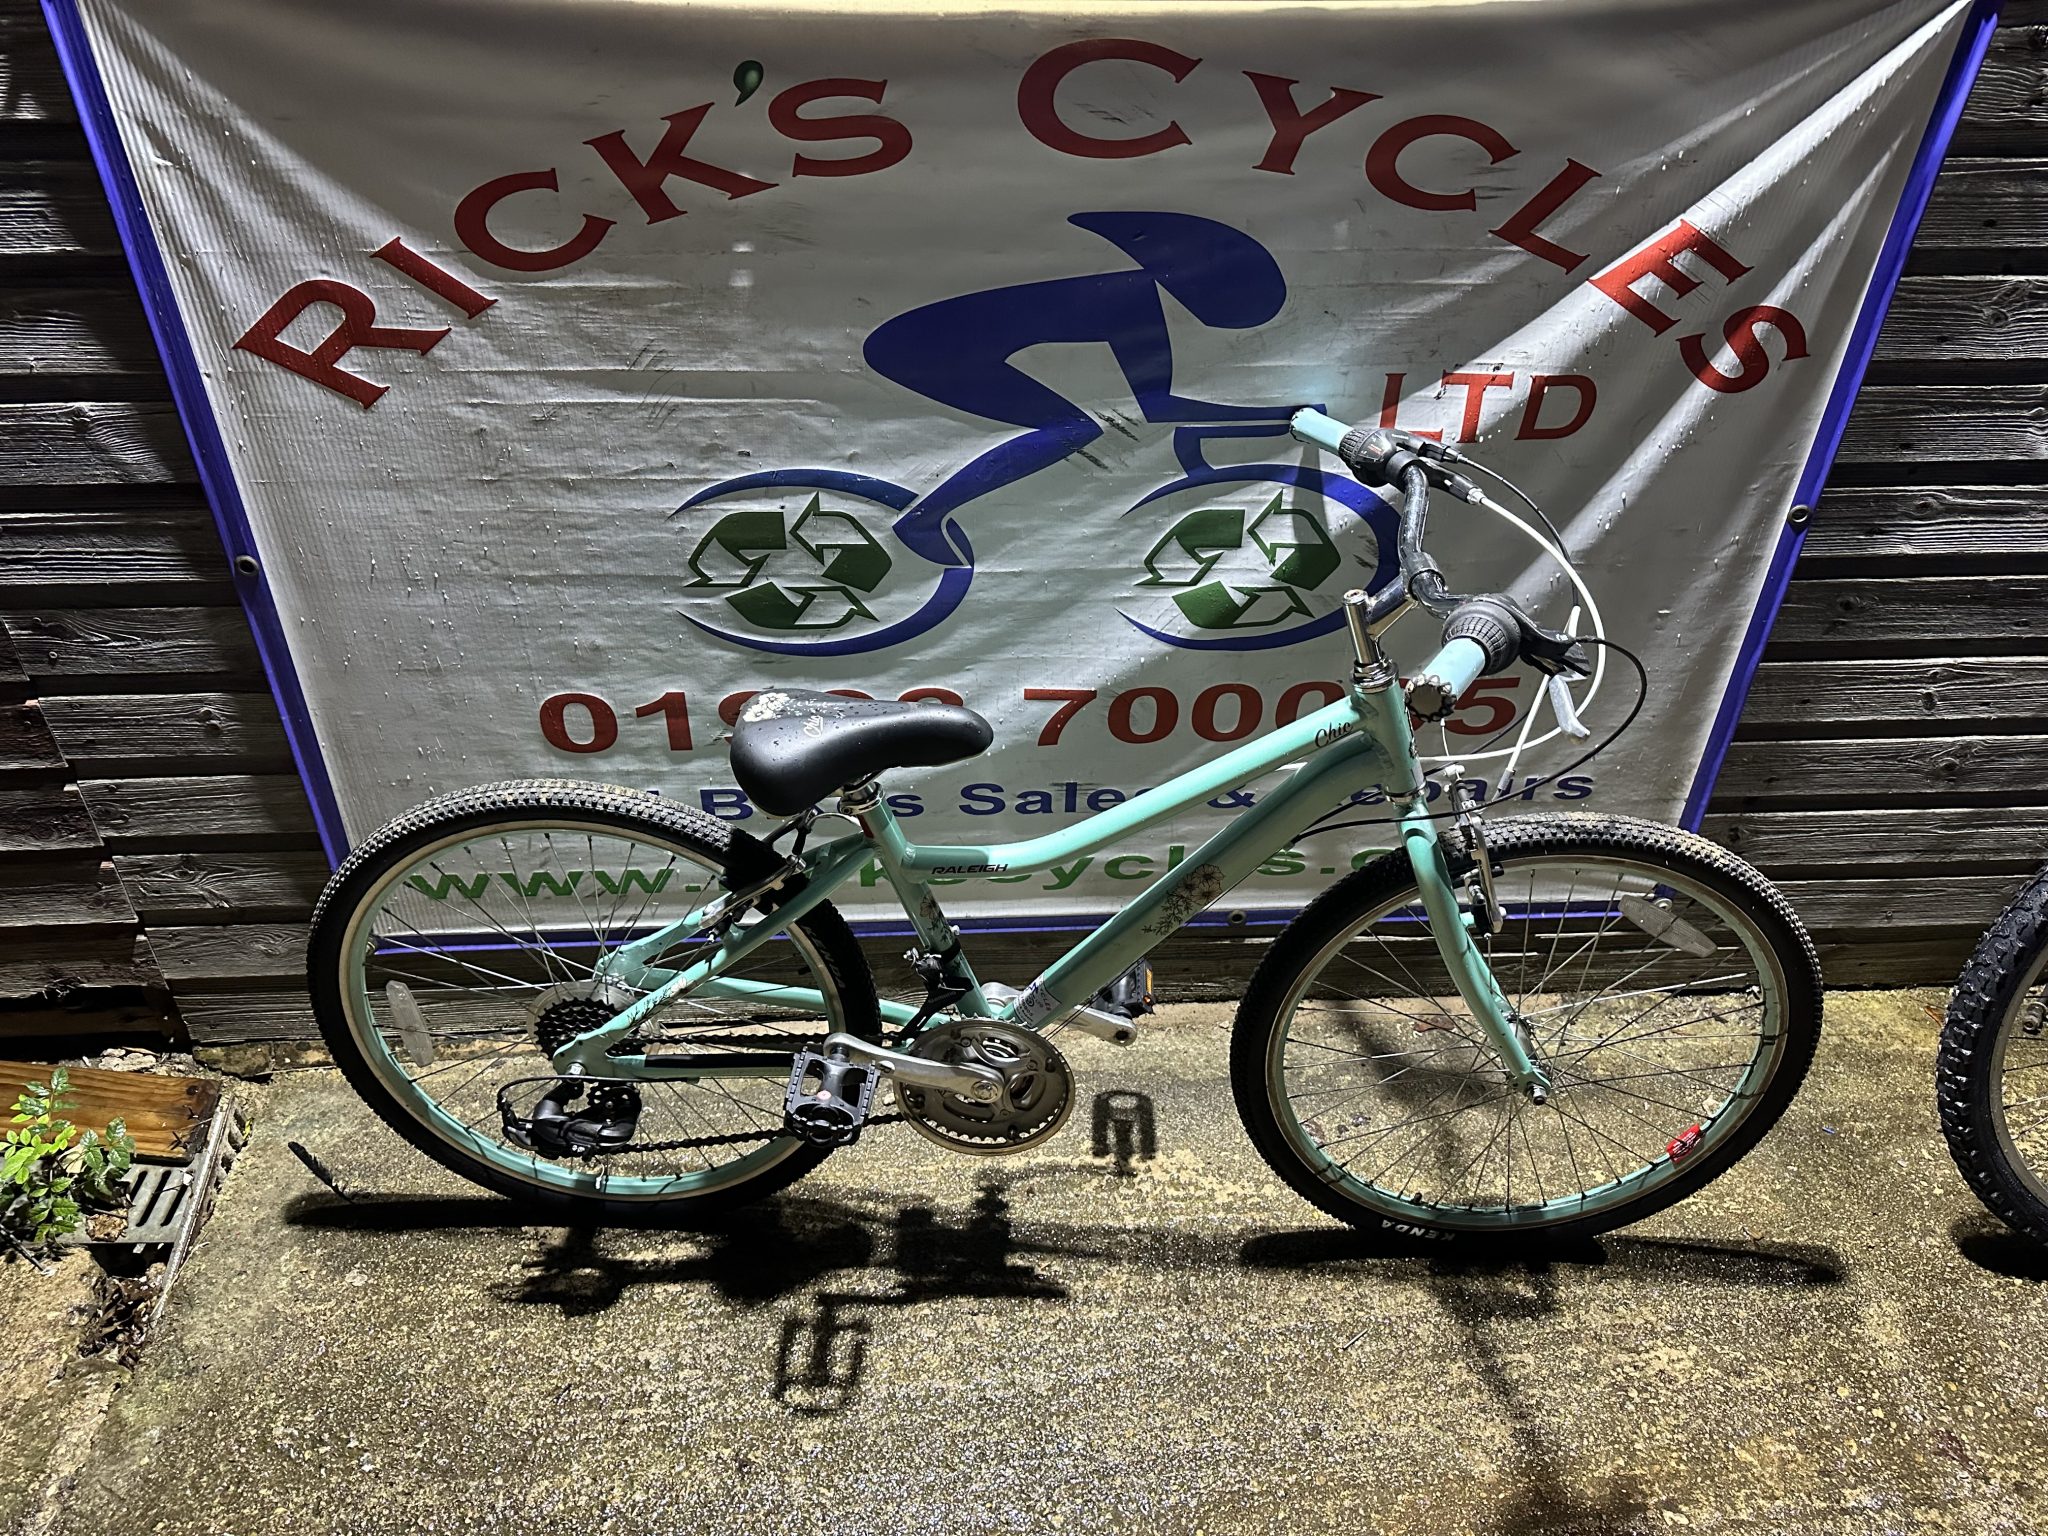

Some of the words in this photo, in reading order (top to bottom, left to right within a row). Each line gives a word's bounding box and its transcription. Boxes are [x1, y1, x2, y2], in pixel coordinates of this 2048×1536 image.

[232, 60, 913, 410] RICK'S
[1017, 38, 1811, 394] CYCLES
[1379, 370, 1598, 443] LTD
[1314, 721, 1355, 749] Chic
[958, 781, 1153, 816] Sale
[931, 863, 1009, 875] RALEIGH
[1381, 1219, 1456, 1242] KENDA
